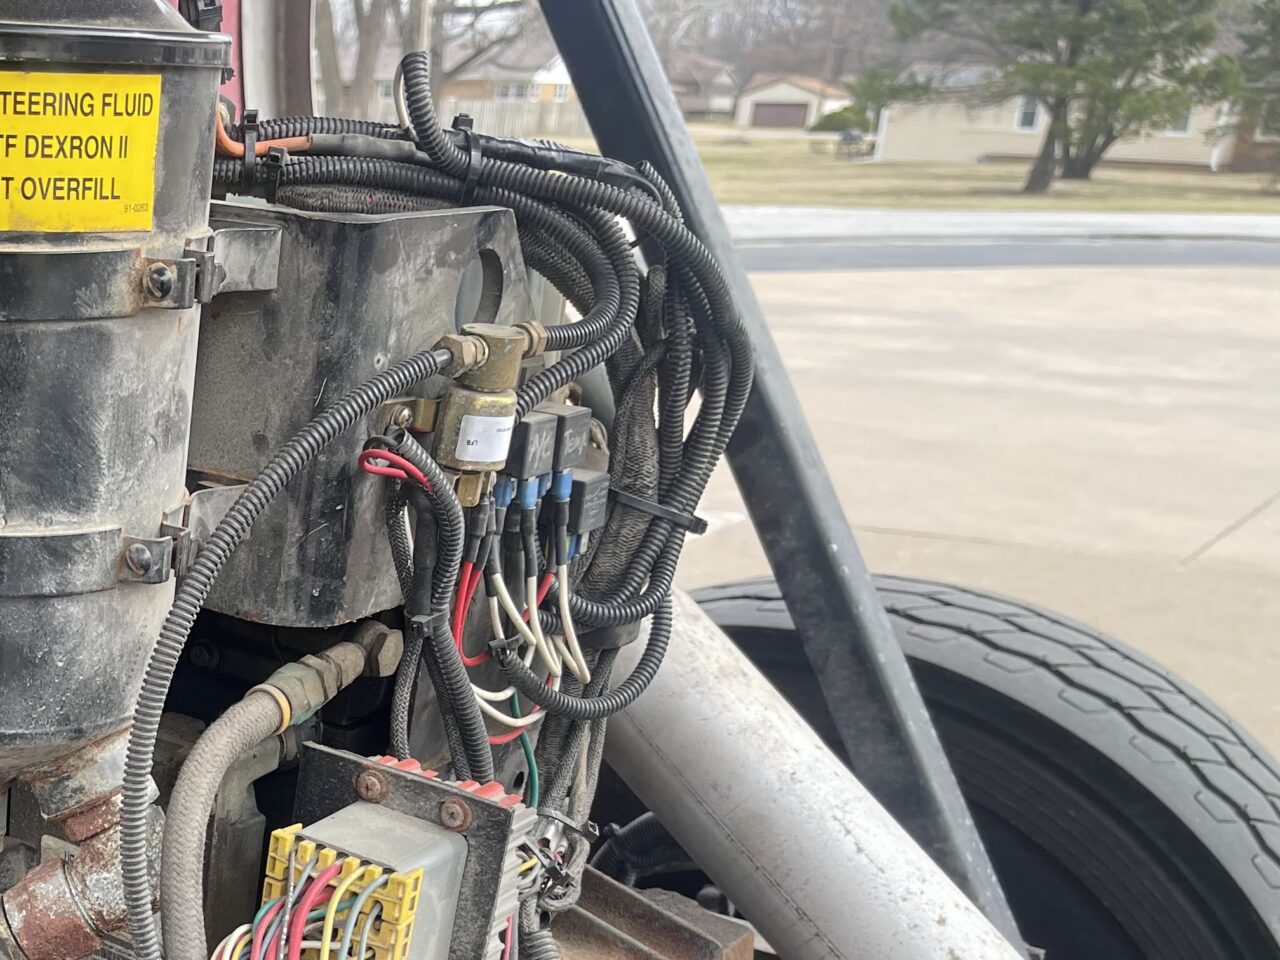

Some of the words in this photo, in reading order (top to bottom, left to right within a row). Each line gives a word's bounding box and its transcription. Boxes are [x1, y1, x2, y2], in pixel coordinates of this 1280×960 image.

[101, 93, 154, 117] FLUID
[25, 135, 113, 159] DEXRON
[118, 136, 129, 159] II
[20, 177, 121, 200] OVERFILL
